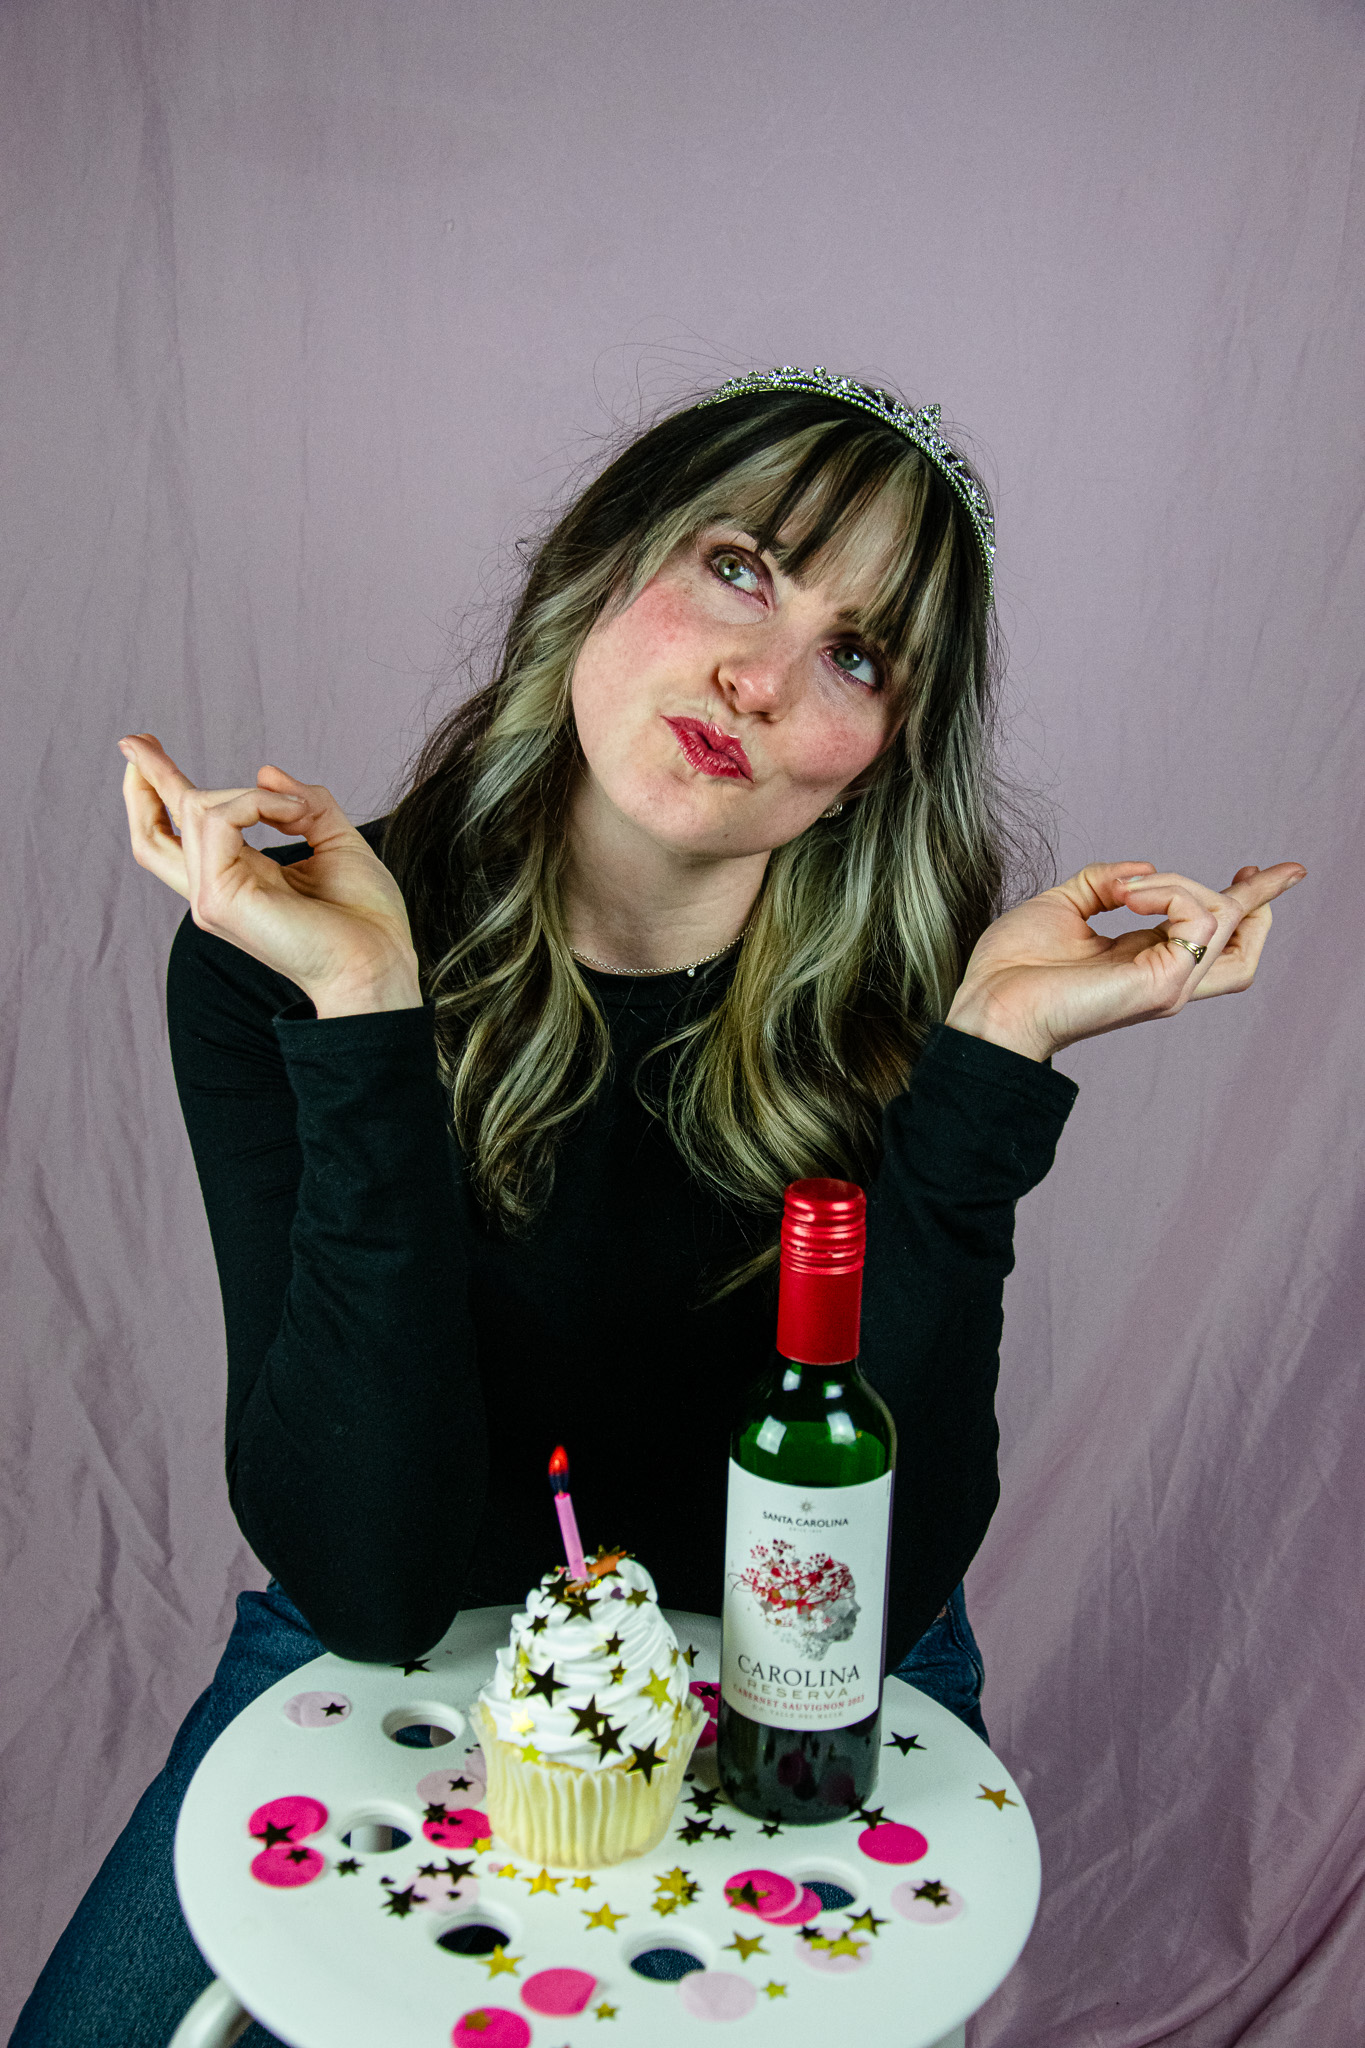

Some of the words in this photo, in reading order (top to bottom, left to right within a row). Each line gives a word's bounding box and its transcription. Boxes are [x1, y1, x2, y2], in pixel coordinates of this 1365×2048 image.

[762, 1510, 793, 1525] SANTA
[795, 1517, 849, 1528] CAROLINA
[738, 1654, 861, 1688] CAROLINA
[733, 1683, 778, 1708] CABERNET
[782, 1701, 845, 1712] SAUVIGNON
[747, 1679, 849, 1701] RESERVA
